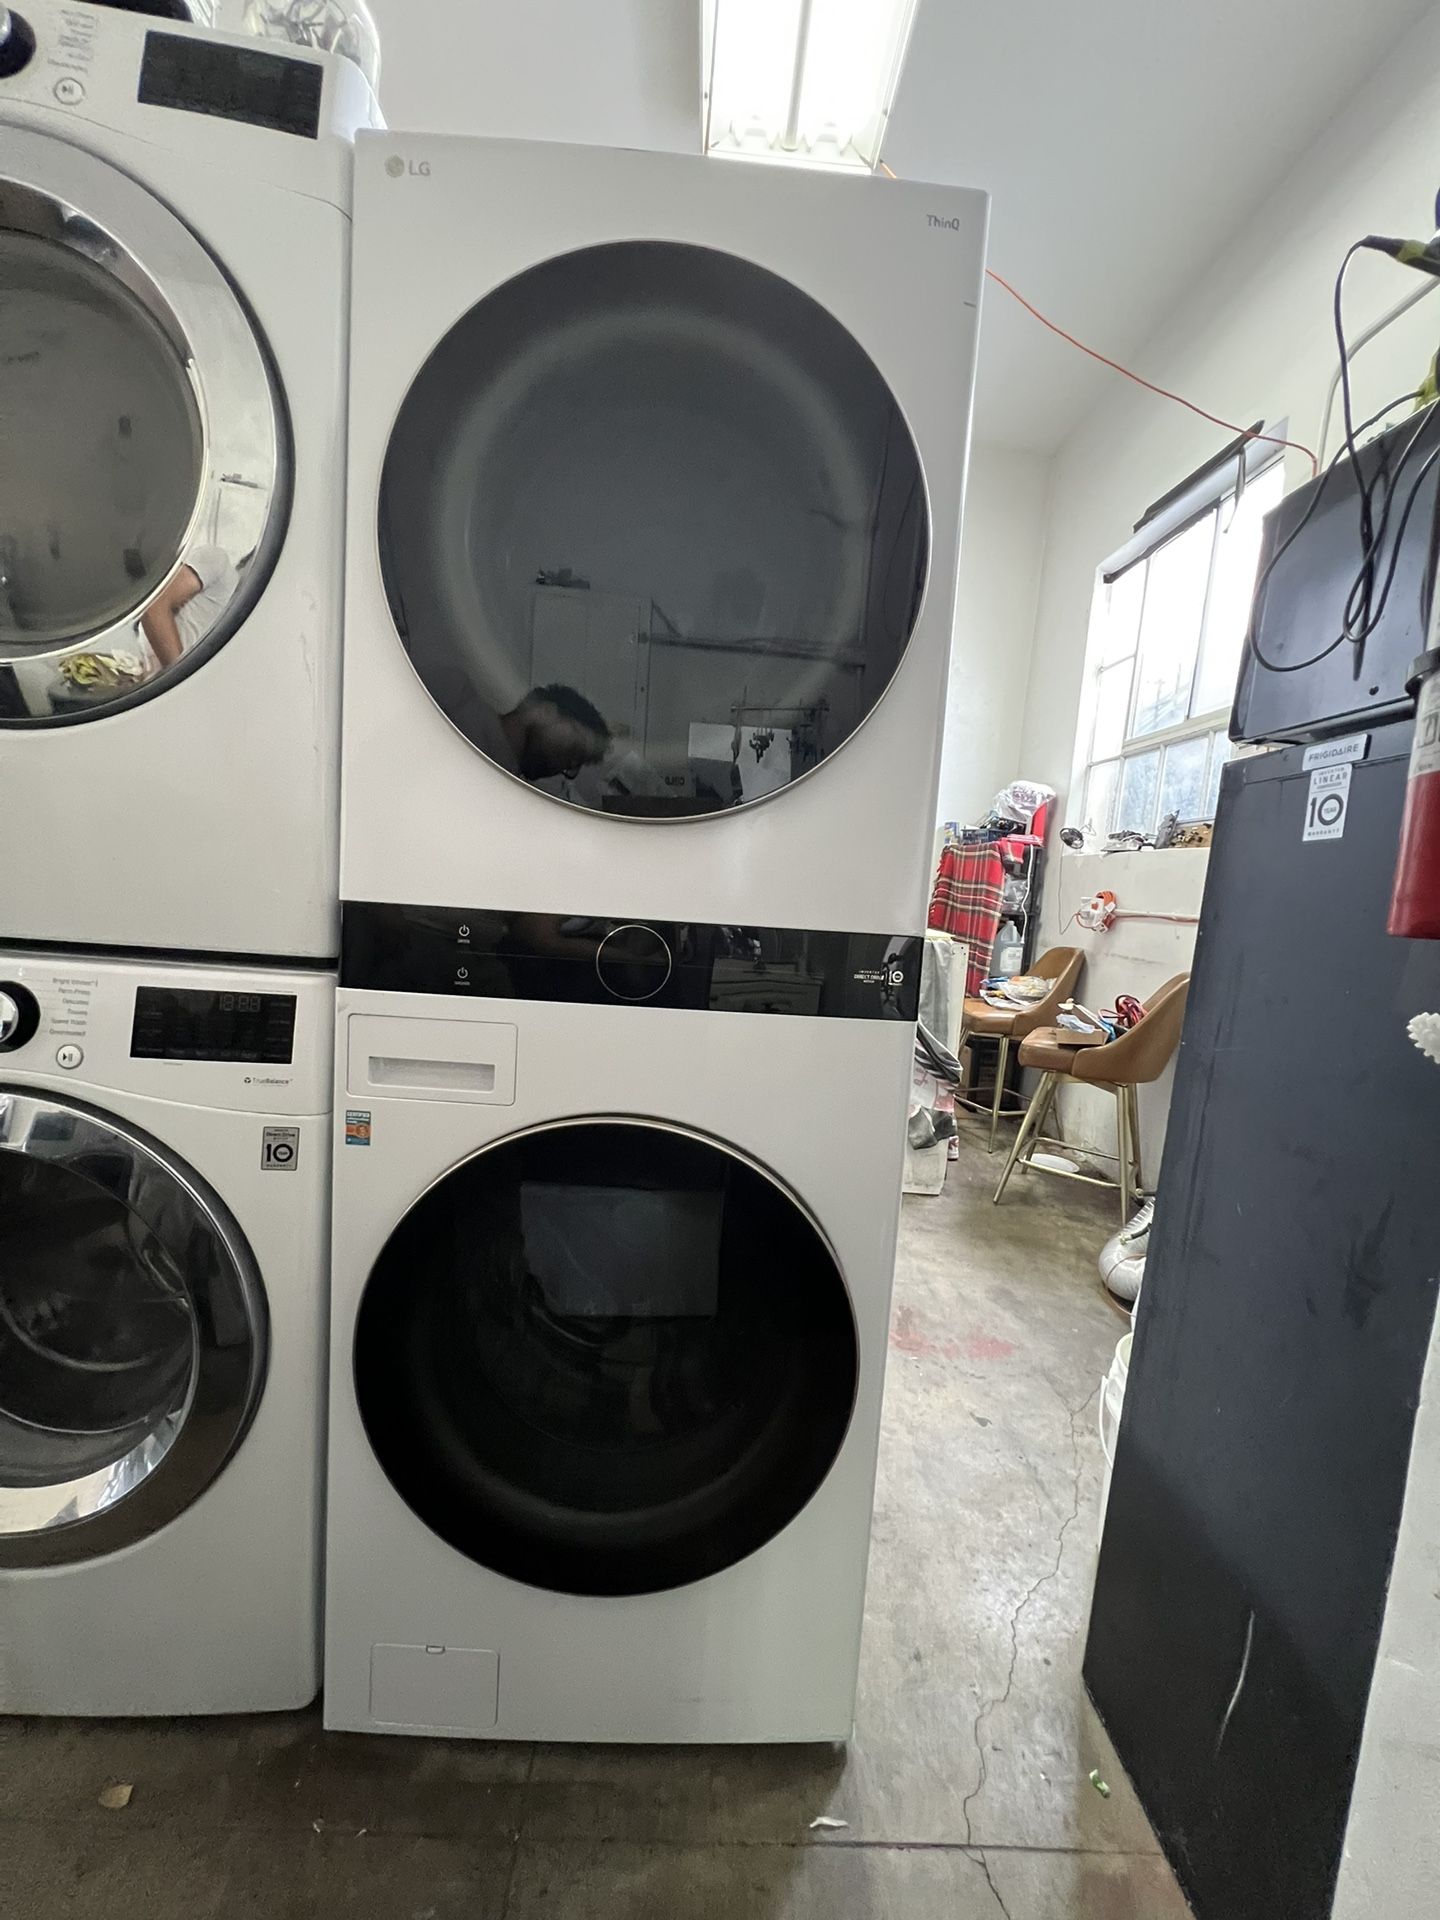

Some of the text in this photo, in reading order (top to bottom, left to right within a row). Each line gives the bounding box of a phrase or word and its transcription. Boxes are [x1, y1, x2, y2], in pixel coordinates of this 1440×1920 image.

[408, 159, 431, 177] LG
[926, 214, 960, 232] ThinQ
[1308, 743, 1360, 761] FRIGIDAIRE
[1313, 772, 1348, 785] LINEAR
[1309, 793, 1344, 828] 10
[266, 1143, 294, 1163] 10
